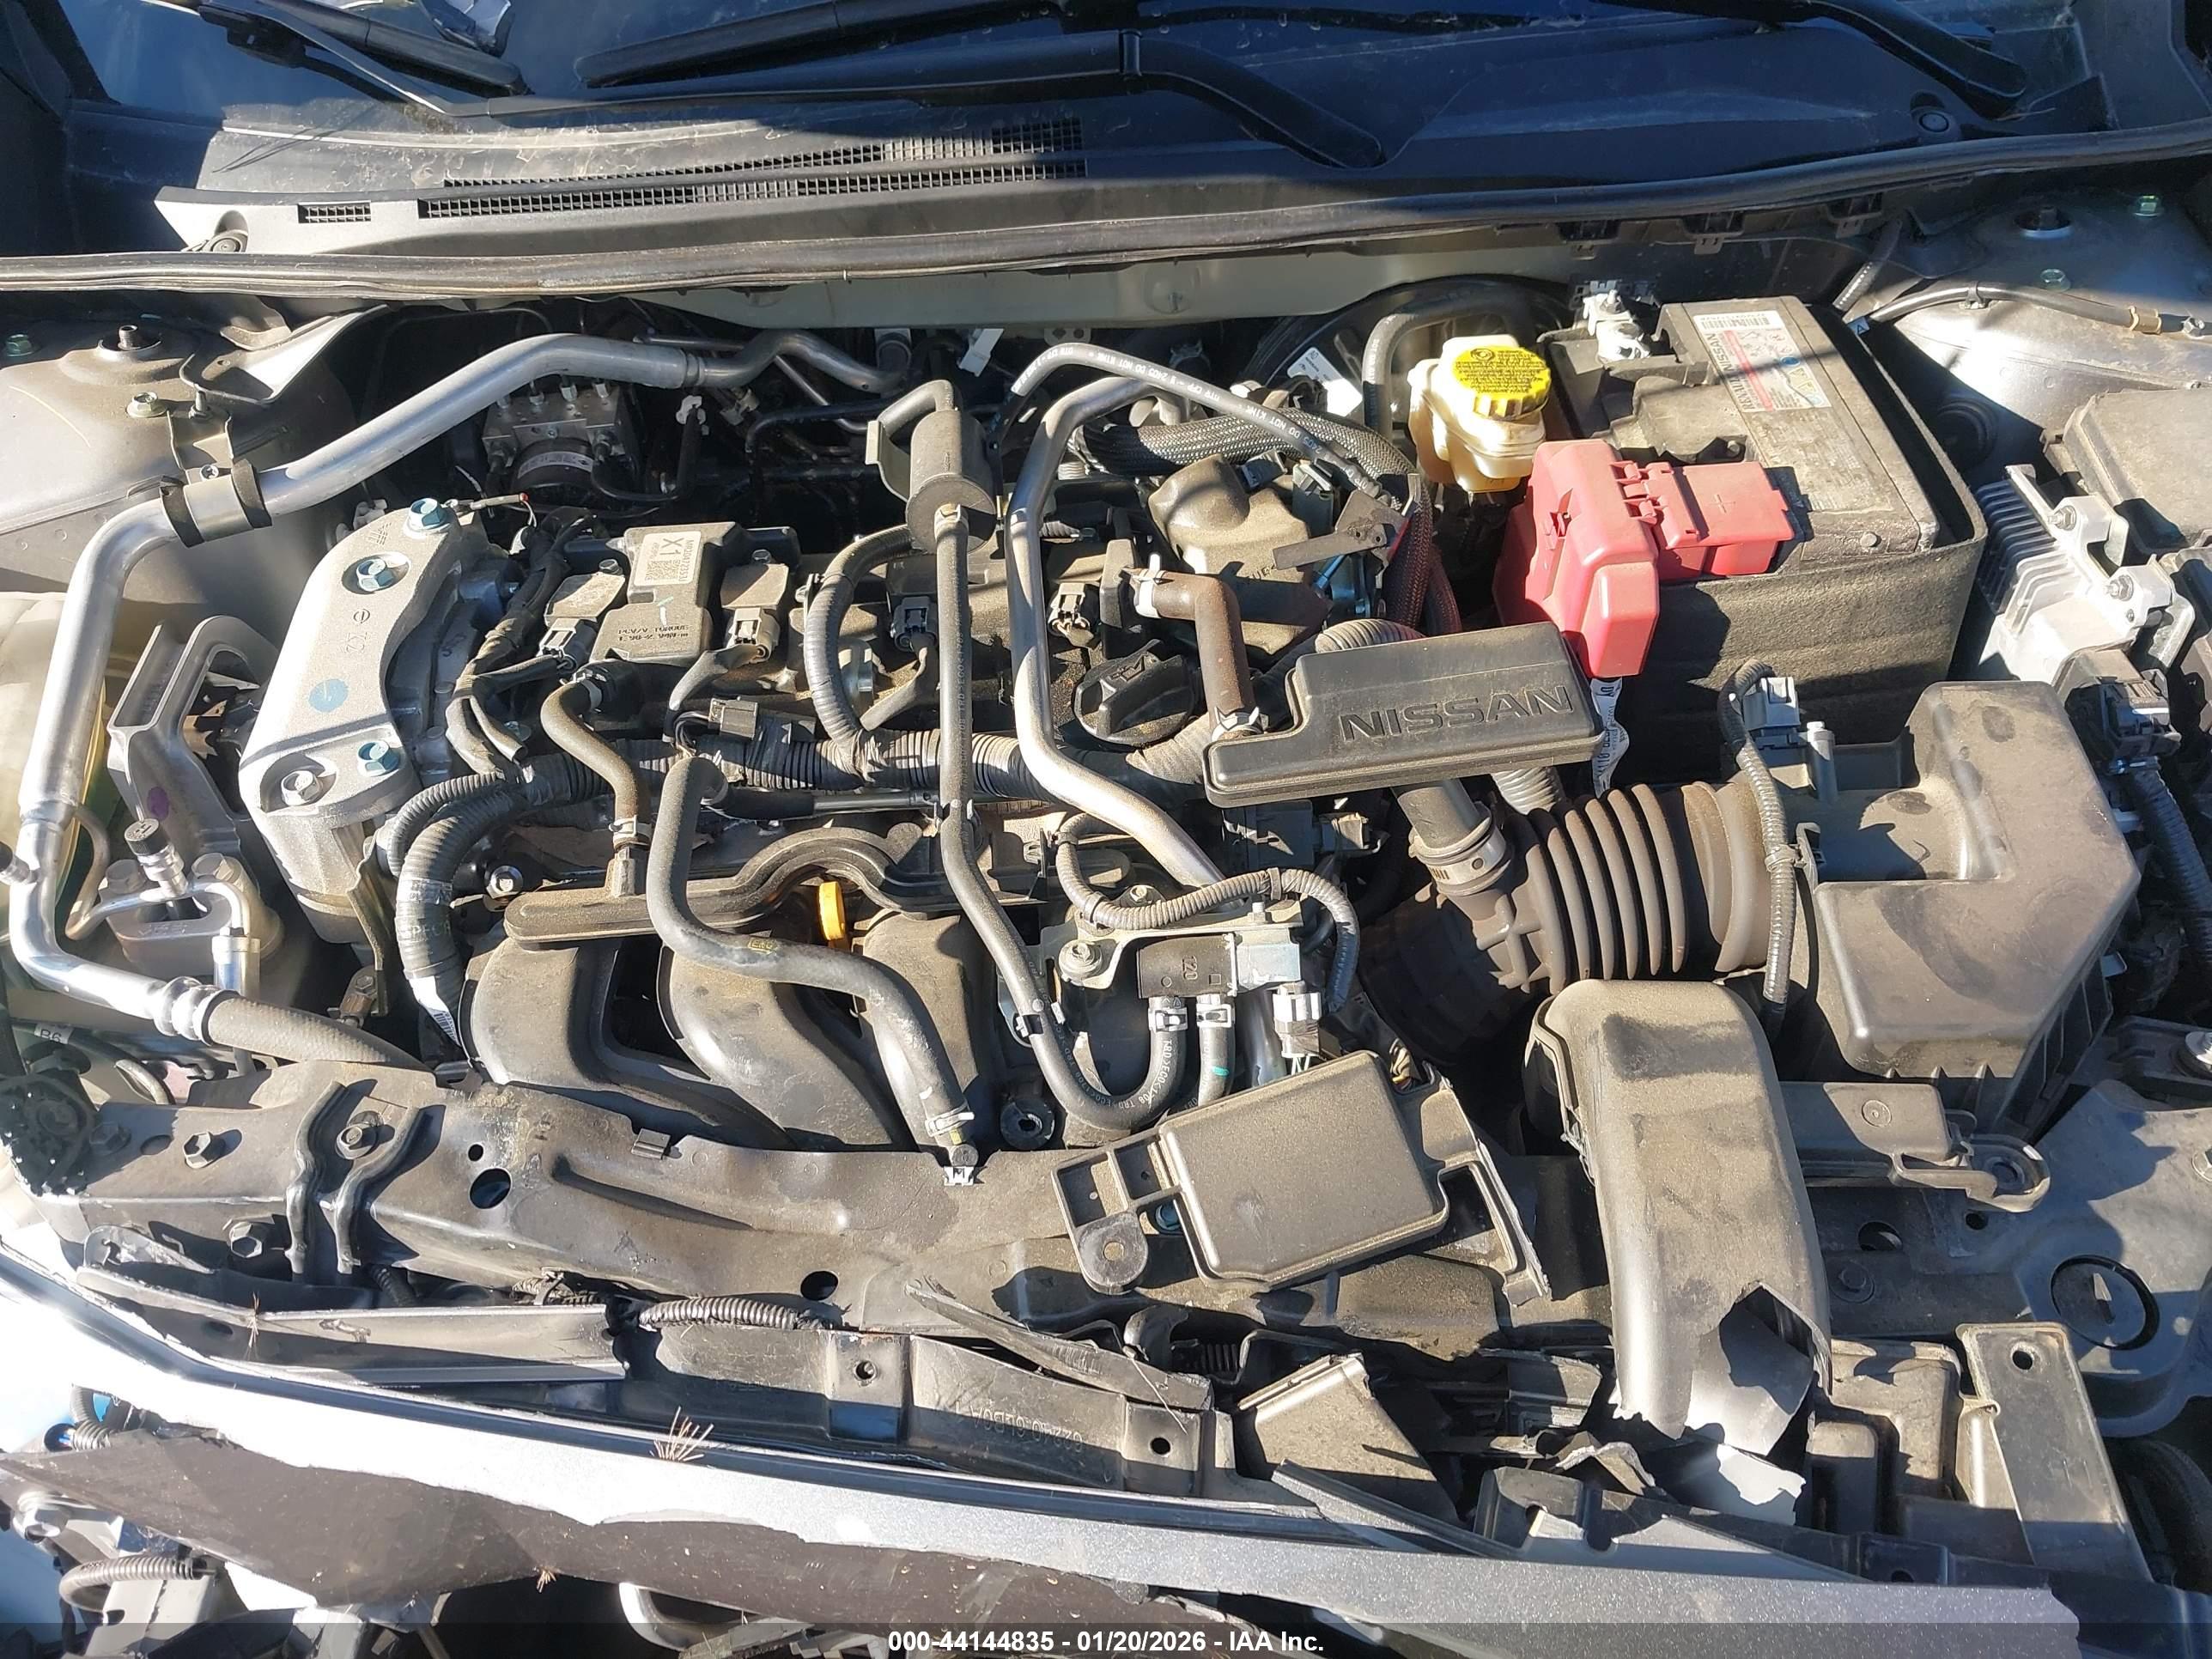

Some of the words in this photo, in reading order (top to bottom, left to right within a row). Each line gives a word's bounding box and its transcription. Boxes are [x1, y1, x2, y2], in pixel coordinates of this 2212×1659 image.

[1704, 331, 1735, 372] NISSAN
[1246, 405, 1267, 420] KINK
[1269, 416, 1287, 431] NOT
[659, 538, 684, 556] X1
[1339, 684, 1575, 742] NISSAN
[1182, 956, 1199, 981] 120
